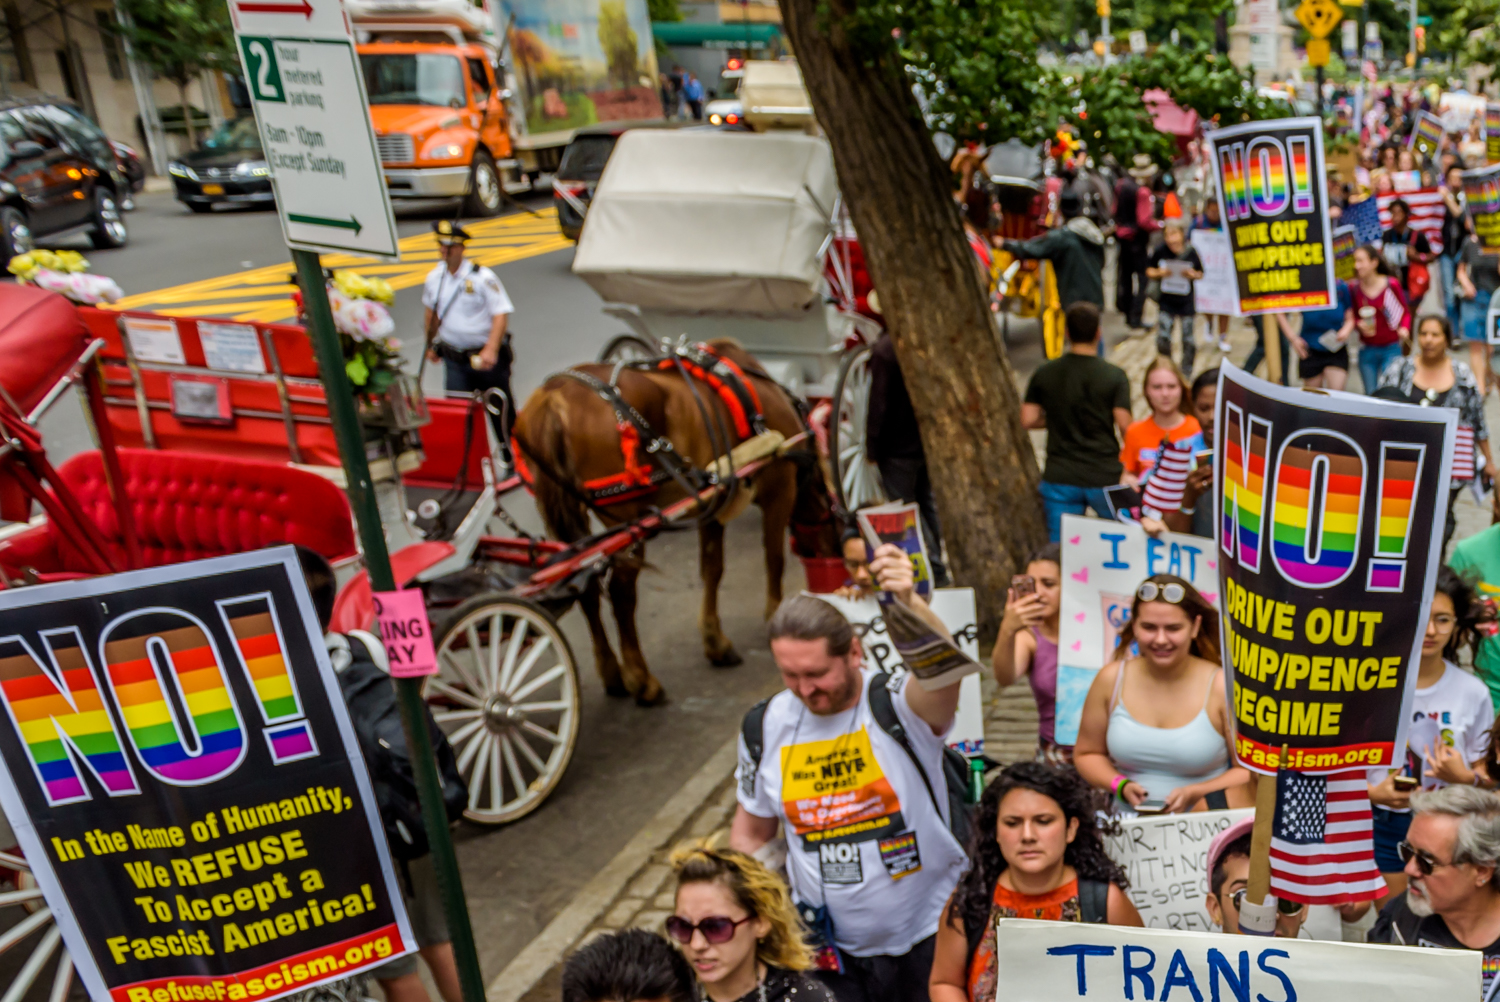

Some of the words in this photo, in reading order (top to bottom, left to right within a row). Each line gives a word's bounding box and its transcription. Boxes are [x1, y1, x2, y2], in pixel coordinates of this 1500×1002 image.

[249, 40, 279, 98] 2
[284, 68, 324, 86] metered
[288, 91, 325, 111] parking
[295, 125, 325, 148] 10pm
[271, 148, 308, 173] Except
[306, 152, 347, 180] Sunday
[1218, 135, 1315, 222] NO!
[1270, 219, 1309, 244] OUT
[1221, 400, 1427, 593] NO!
[1100, 532, 1130, 569] I
[1147, 537, 1203, 583] EAT
[1227, 576, 1297, 642] DRIVE
[1305, 606, 1383, 647] OUT
[383, 618, 424, 641] ING
[388, 644, 415, 664] AY
[1226, 632, 1401, 692] UMP/PENCE
[0, 591, 320, 807] NO!
[804, 746, 860, 767] America
[821, 757, 866, 780] NEVE
[1235, 739, 1384, 769] eFascism.org
[51, 835, 84, 862] In
[84, 827, 129, 857] the
[126, 822, 186, 853] Name
[191, 811, 221, 841] of
[220, 785, 354, 833] Humanity,
[1106, 826, 1157, 854] MR.
[1154, 816, 1232, 850] TRUMP
[123, 860, 172, 889] We
[170, 829, 309, 888] REFUSE
[820, 843, 860, 864] NO!
[134, 896, 173, 924] To
[177, 872, 293, 923] Accept
[299, 868, 325, 893] a
[1131, 880, 1209, 910] ESPEC
[105, 929, 216, 965] Fascist
[222, 883, 378, 953] America!
